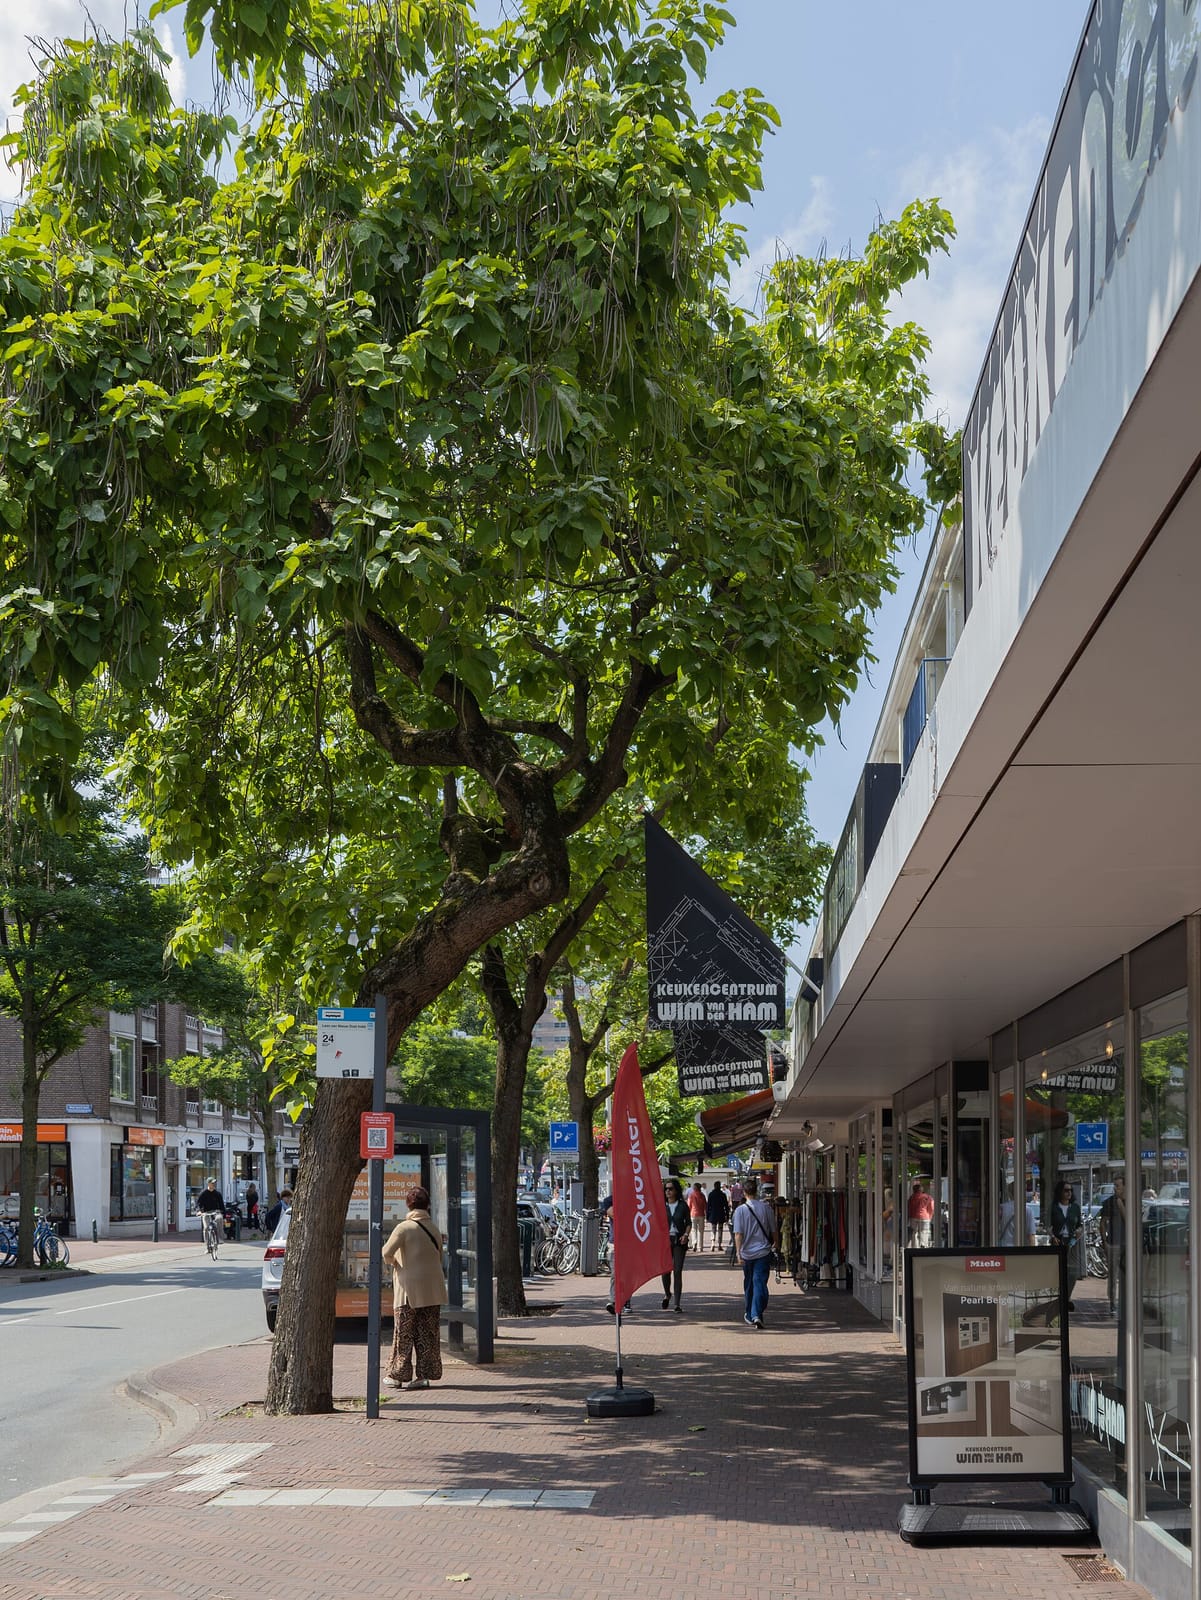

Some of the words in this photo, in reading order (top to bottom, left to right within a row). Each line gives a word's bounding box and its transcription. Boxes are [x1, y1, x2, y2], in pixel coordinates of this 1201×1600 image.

[656, 983, 778, 996] KEUKENCENTRUM
[657, 1001, 704, 1021] WIM
[706, 1002, 725, 1011] VAN
[728, 1001, 778, 1021] HAM
[707, 1012, 725, 1021] DEN
[322, 1034, 334, 1043] 24
[682, 1059, 762, 1076] KEUKENCENTRUM
[683, 1076, 716, 1092] WIM
[730, 1071, 764, 1087] HAM
[553, 1131, 563, 1144] P
[626, 1108, 652, 1243] Quooker
[970, 1260, 1001, 1268] Miele
[960, 1295, 984, 1305] Pearl
[986, 1295, 1012, 1306] Beige
[956, 1453, 983, 1464] WIM
[996, 1452, 1024, 1463] HAM
